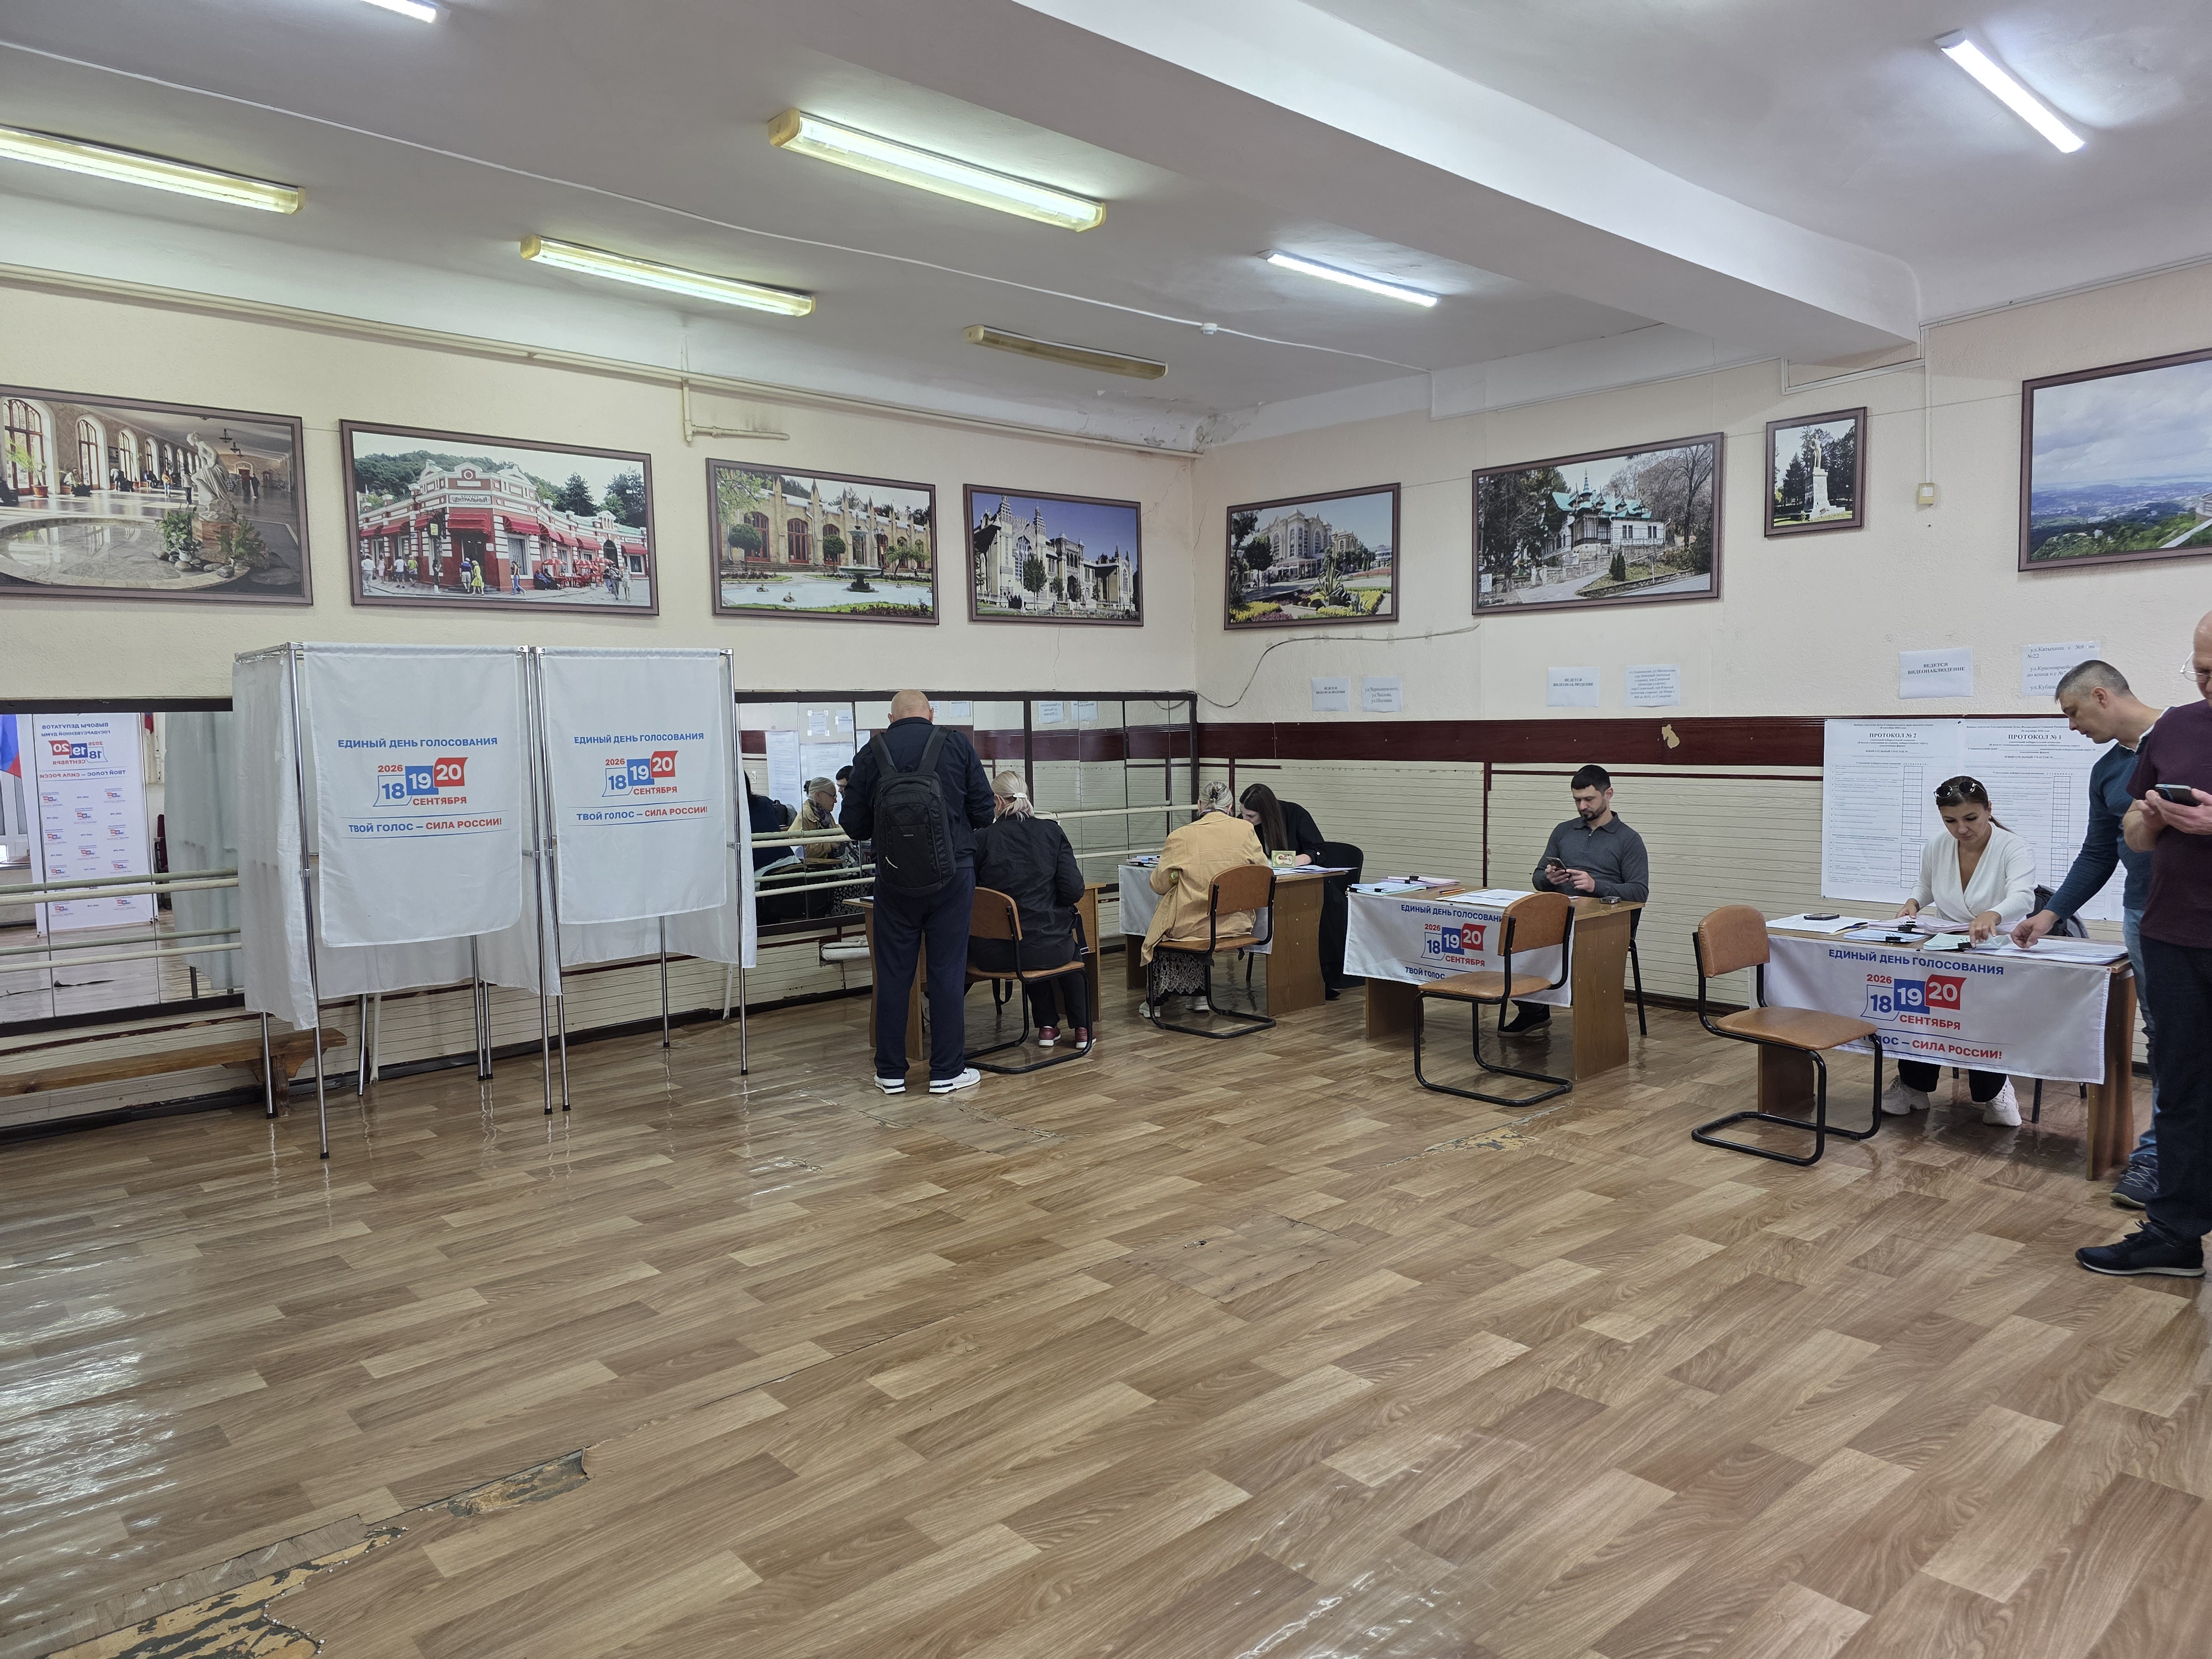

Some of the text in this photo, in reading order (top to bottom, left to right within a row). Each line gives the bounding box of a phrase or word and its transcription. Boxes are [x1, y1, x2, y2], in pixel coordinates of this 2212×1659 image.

[338, 738, 498, 748] ЕДИНЫЙ ДЕНЬ ГОЛОСОВАНИЯ
[574, 733, 704, 744] ЕДИНЫЙ ДЕНЬ ГОЛОСОВАНИЯ
[608, 757, 672, 790] 18 19 20
[382, 764, 462, 800] 18 19 20
[633, 786, 677, 795] СЕНТЯБРЯ
[413, 797, 467, 806] СЕНТЯБРЯ
[576, 812, 602, 821] ТВОЙ
[604, 811, 634, 820] ГОЛОС
[645, 808, 667, 817] СИЛА
[670, 806, 707, 815] РОССИИ!
[348, 823, 374, 832] ТВОЙ
[377, 823, 413, 832] ГОЛОС
[425, 821, 455, 830] СИЛА
[457, 818, 502, 828] РОССИИ!
[1401, 904, 1502, 922] ЕДИНЫЙ ДЕНЬ ГОЛОСОВАНИ
[1427, 929, 1481, 954] 18 19 20
[1446, 956, 1485, 967] СЕНТЯБРЯ
[1829, 949, 2004, 975] ЕДИНЫЙ ДЕНЬ ГОЛОСОВАНИЯ
[1405, 967, 1445, 979] ТВОЙ ГОЛОС
[1866, 974, 1892, 984] 2026
[1870, 982, 1958, 1013] 18 19 20
[1900, 1014, 1961, 1030] СЕНТЯБРЯ
[1912, 1039, 1945, 1053] СИЛА
[1948, 1044, 2002, 1060] РОССИИ!
